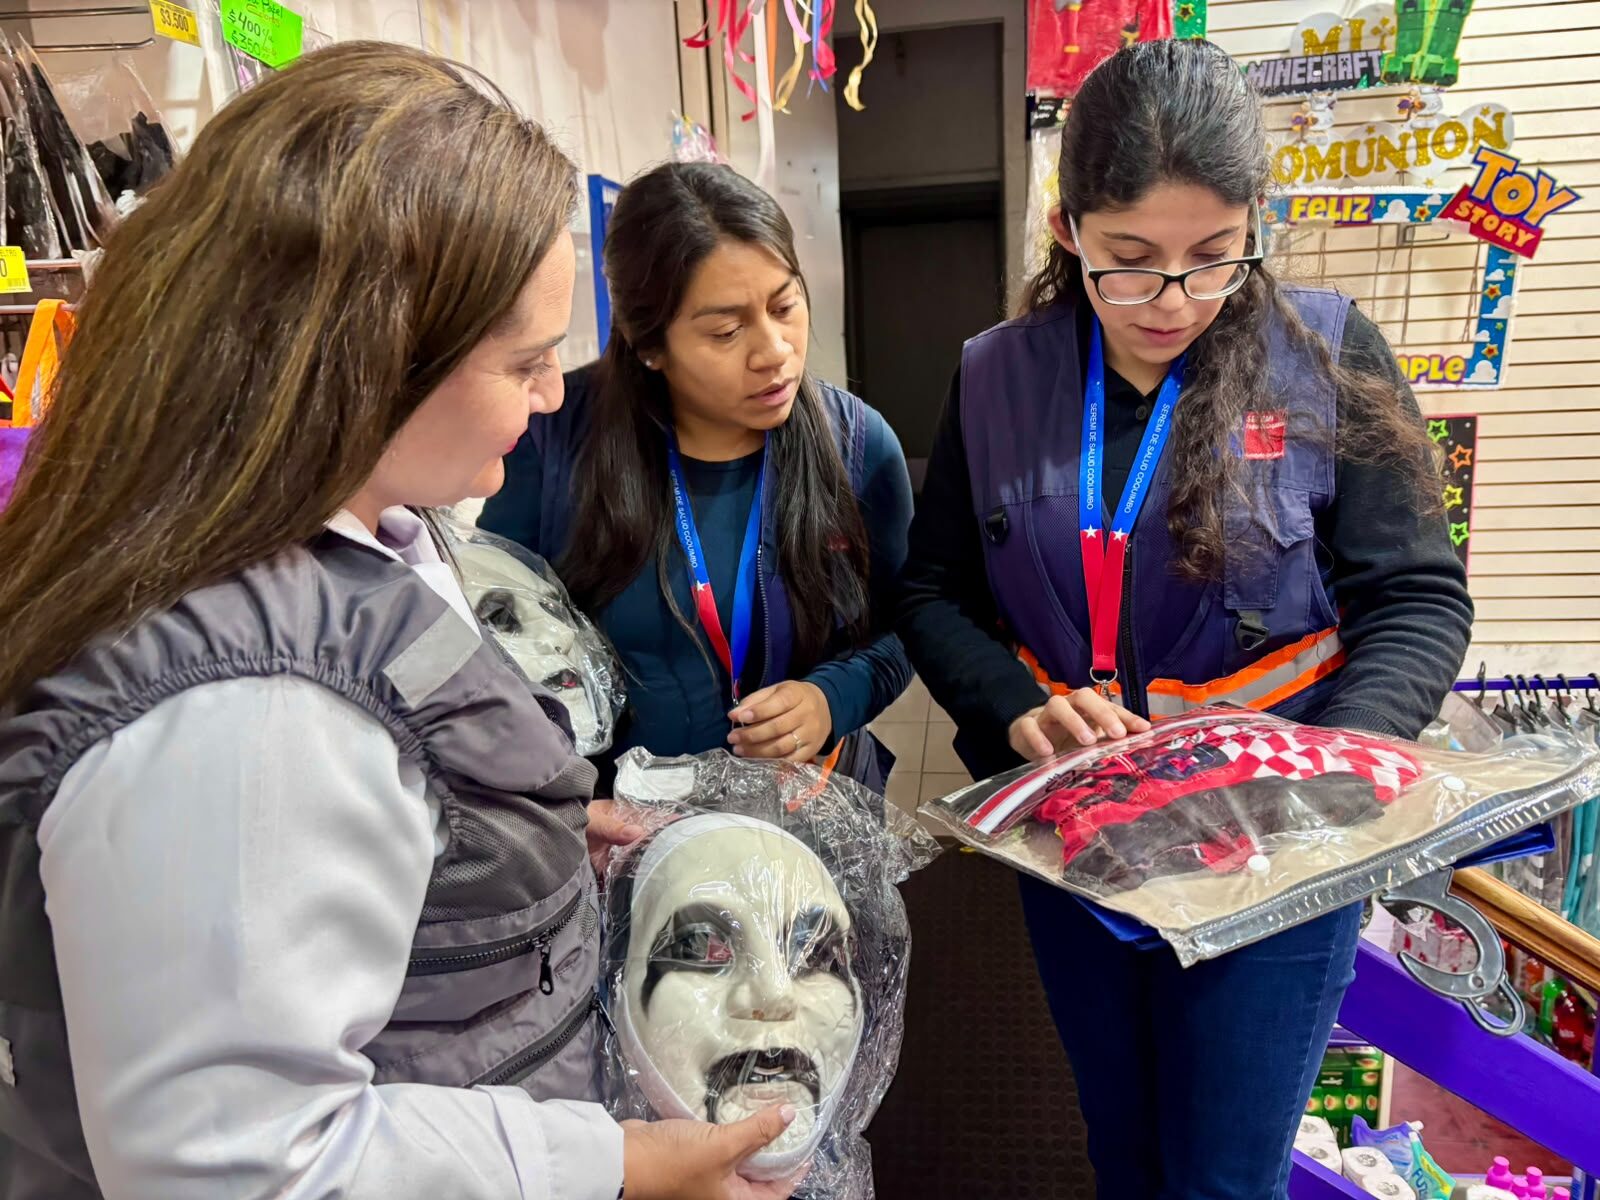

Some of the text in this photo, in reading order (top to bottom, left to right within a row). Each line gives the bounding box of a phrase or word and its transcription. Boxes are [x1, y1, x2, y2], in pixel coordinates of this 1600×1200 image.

[160, 8, 189, 32] $3.500
[1247, 50, 1382, 88] MINECRAFT
[1473, 147, 1580, 226] TOY
[1454, 200, 1536, 248] STORY
[1086, 402, 1098, 510] SEREMI DE SALUD COQUIMBO
[1123, 403, 1170, 514] SEREMI DE SALUD COQUIMBO
[683, 530, 698, 568] COQUIMBO
